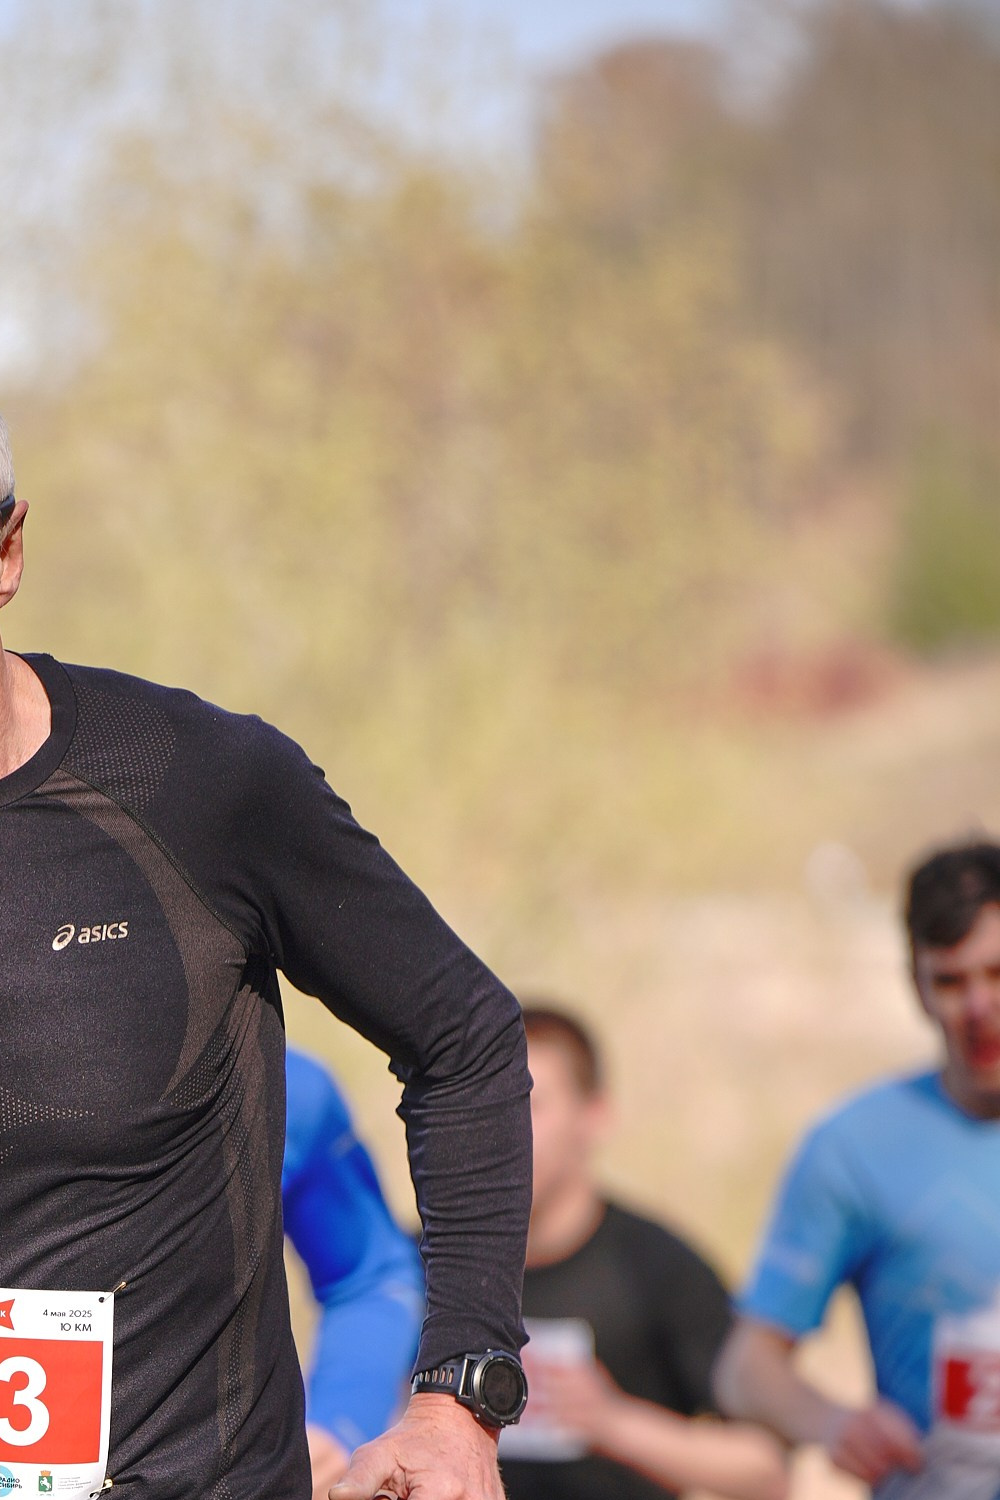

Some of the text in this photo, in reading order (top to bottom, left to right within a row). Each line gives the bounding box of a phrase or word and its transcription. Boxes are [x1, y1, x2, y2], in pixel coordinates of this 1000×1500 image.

[78, 921, 128, 944] asics
[43, 1309, 48, 1317] 4
[69, 1310, 93, 1318] 2025
[60, 1322, 92, 1332] 10 КМ
